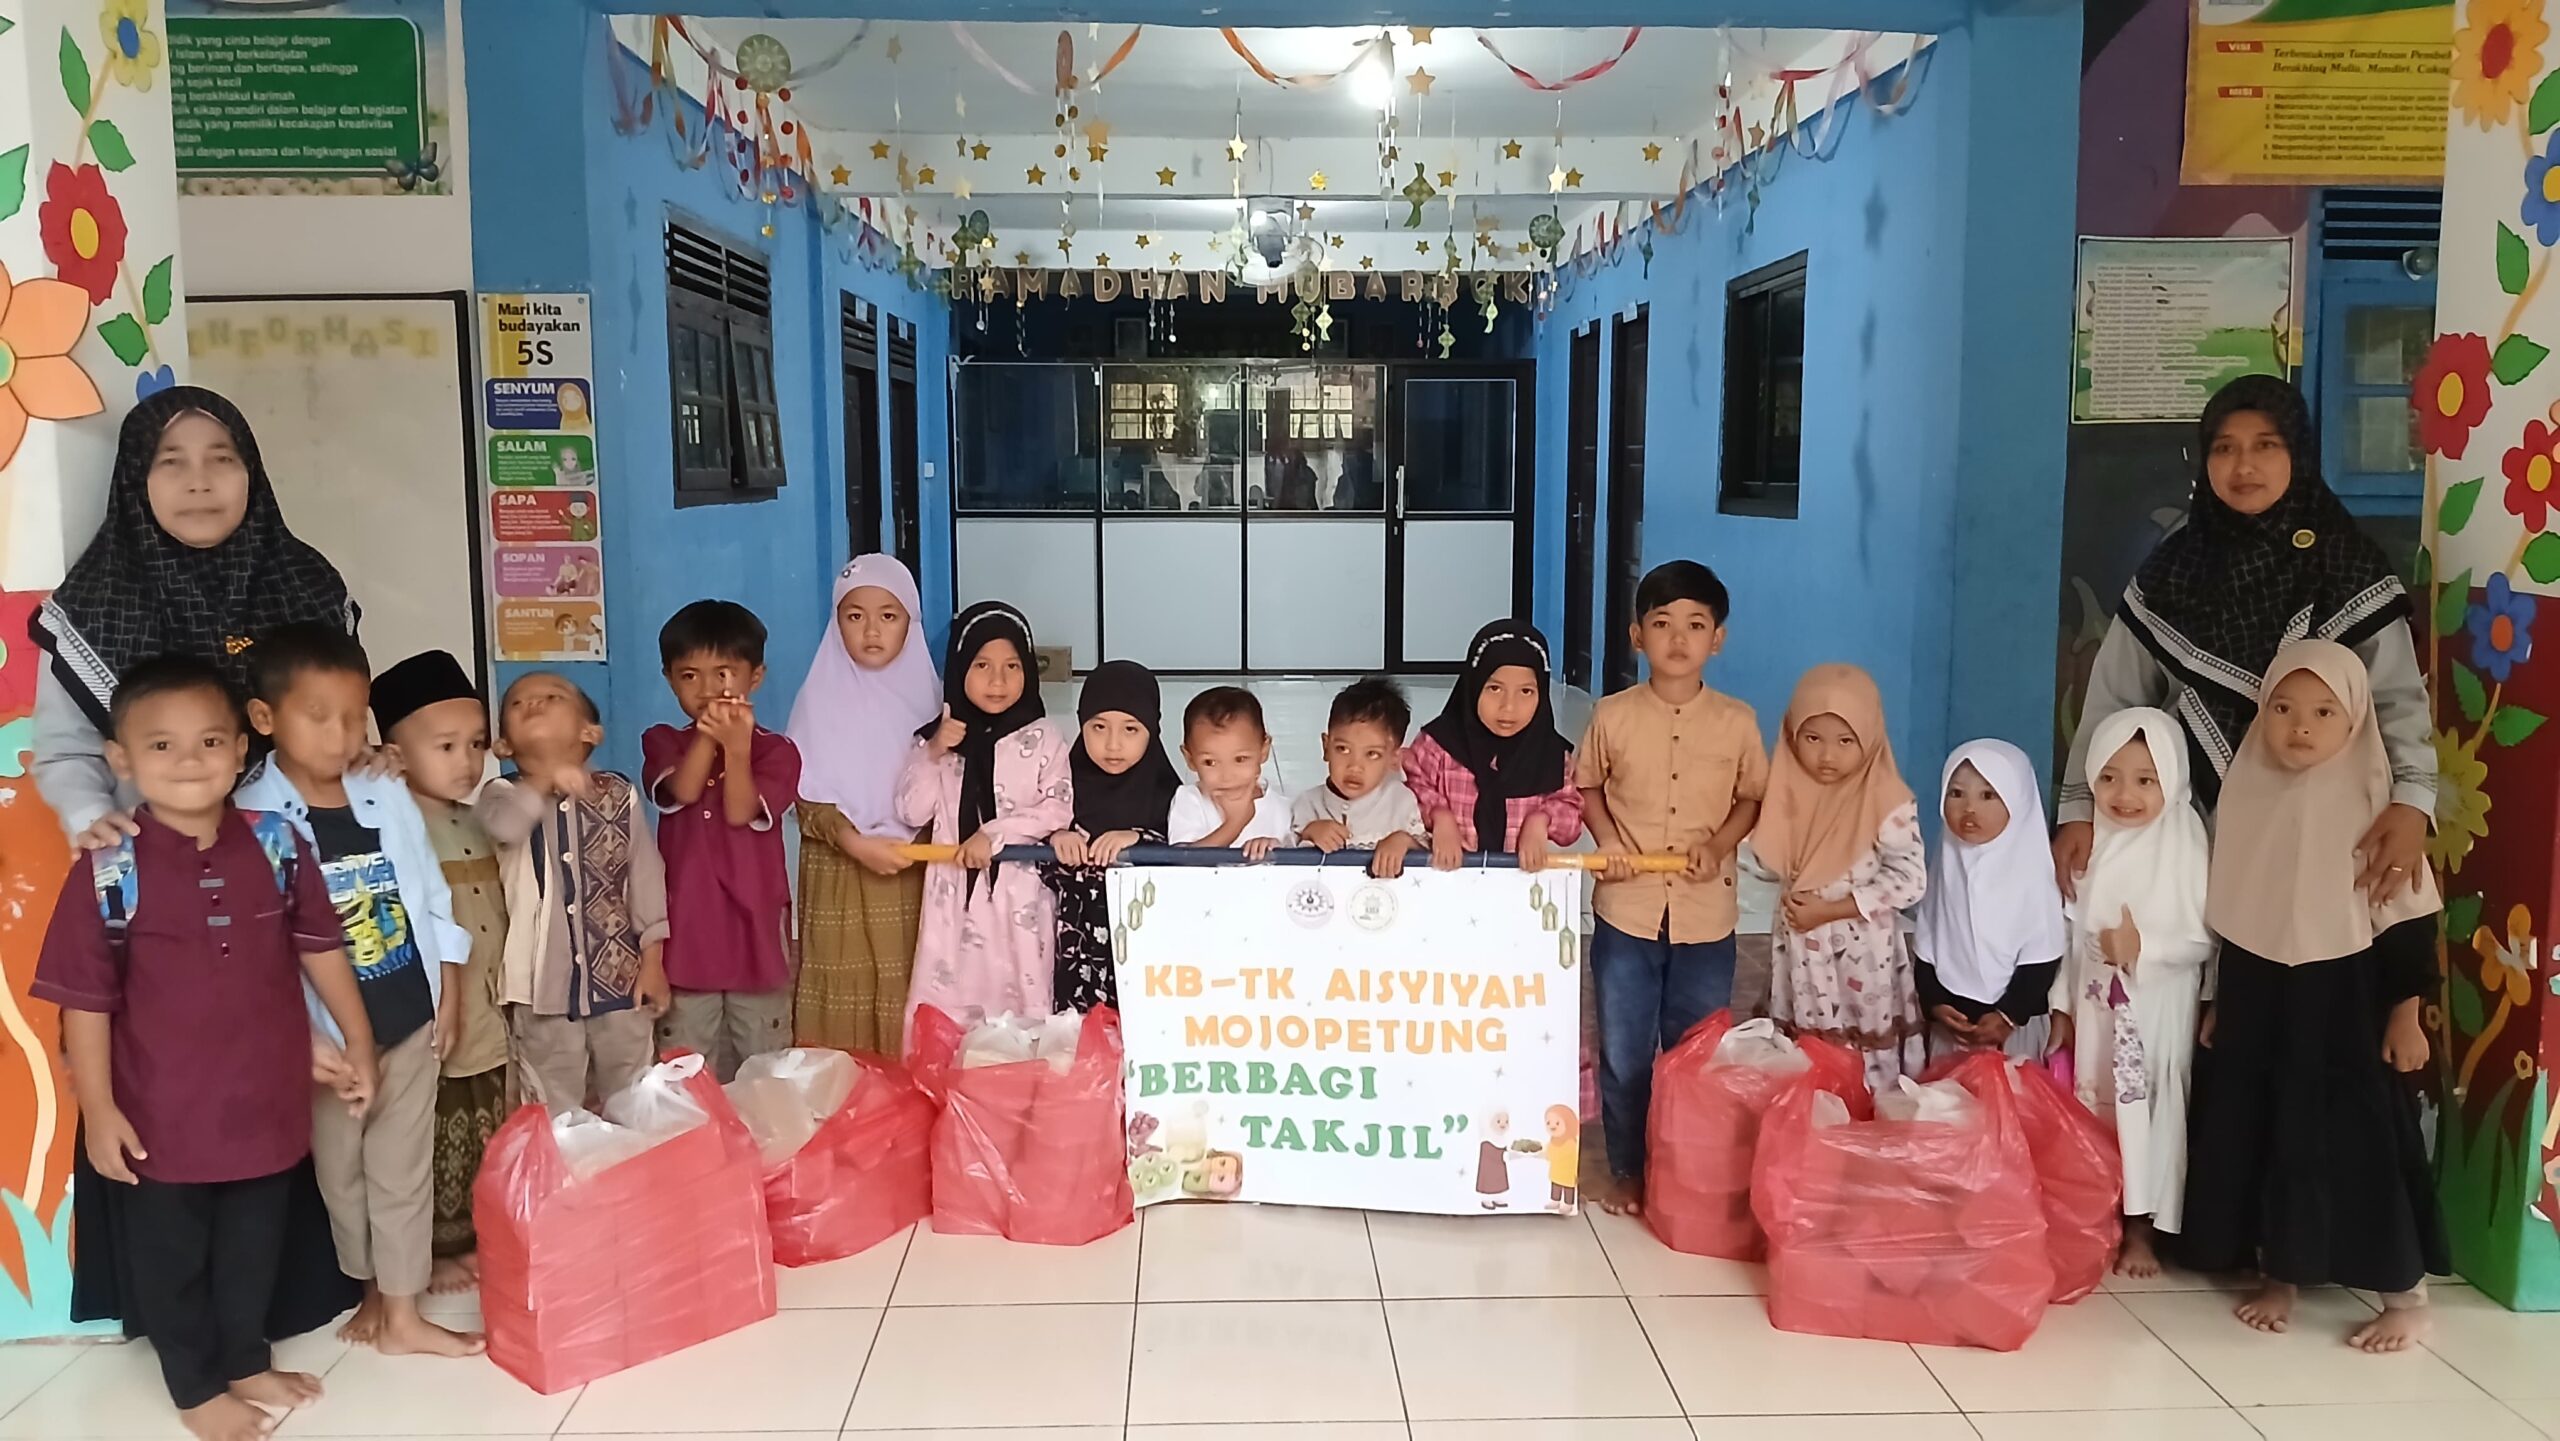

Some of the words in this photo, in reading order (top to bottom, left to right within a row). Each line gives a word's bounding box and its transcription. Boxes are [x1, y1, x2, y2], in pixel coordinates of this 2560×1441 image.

[195, 37, 222, 48] yang
[225, 36, 250, 46] cinta
[253, 35, 288, 48] belajar
[291, 35, 331, 48] dengan
[175, 49, 206, 60] Islam
[207, 51, 235, 62] yang
[236, 49, 308, 62] berkelanjutan
[187, 63, 232, 74] beriman
[233, 64, 254, 74] dan
[309, 63, 359, 76] sehingga
[216, 77, 242, 88] kecil
[252, 91, 296, 102] karimah
[192, 104, 223, 118] sikap
[224, 104, 266, 116] mandiri
[266, 105, 299, 116] dalam
[301, 104, 338, 118] belajar
[339, 104, 361, 116] dan
[361, 104, 408, 118] kegiatan
[203, 120, 231, 132] yang
[232, 118, 278, 130] memiliki
[278, 118, 337, 132] kecakapan
[337, 118, 394, 130] kreativitas
[195, 147, 236, 160] dengan
[237, 147, 279, 158] sesama
[280, 146, 301, 158] dan
[302, 145, 363, 160] lingkungan
[364, 145, 398, 158] sosial
[951, 267, 1227, 304] RAMADHAN
[497, 302, 530, 316] Mari
[533, 302, 562, 316] kita
[498, 319, 581, 335] budayakan
[517, 340, 554, 366] 5S
[493, 382, 556, 395] SENYUM
[496, 440, 548, 453] SALAM
[498, 493, 537, 506] SAPA
[502, 552, 546, 563] SOPAN
[504, 608, 555, 619] SANTUN
[1324, 967, 1547, 1010] AISYIYAH
[1184, 1014, 1508, 1055] MOJOPETUNG
